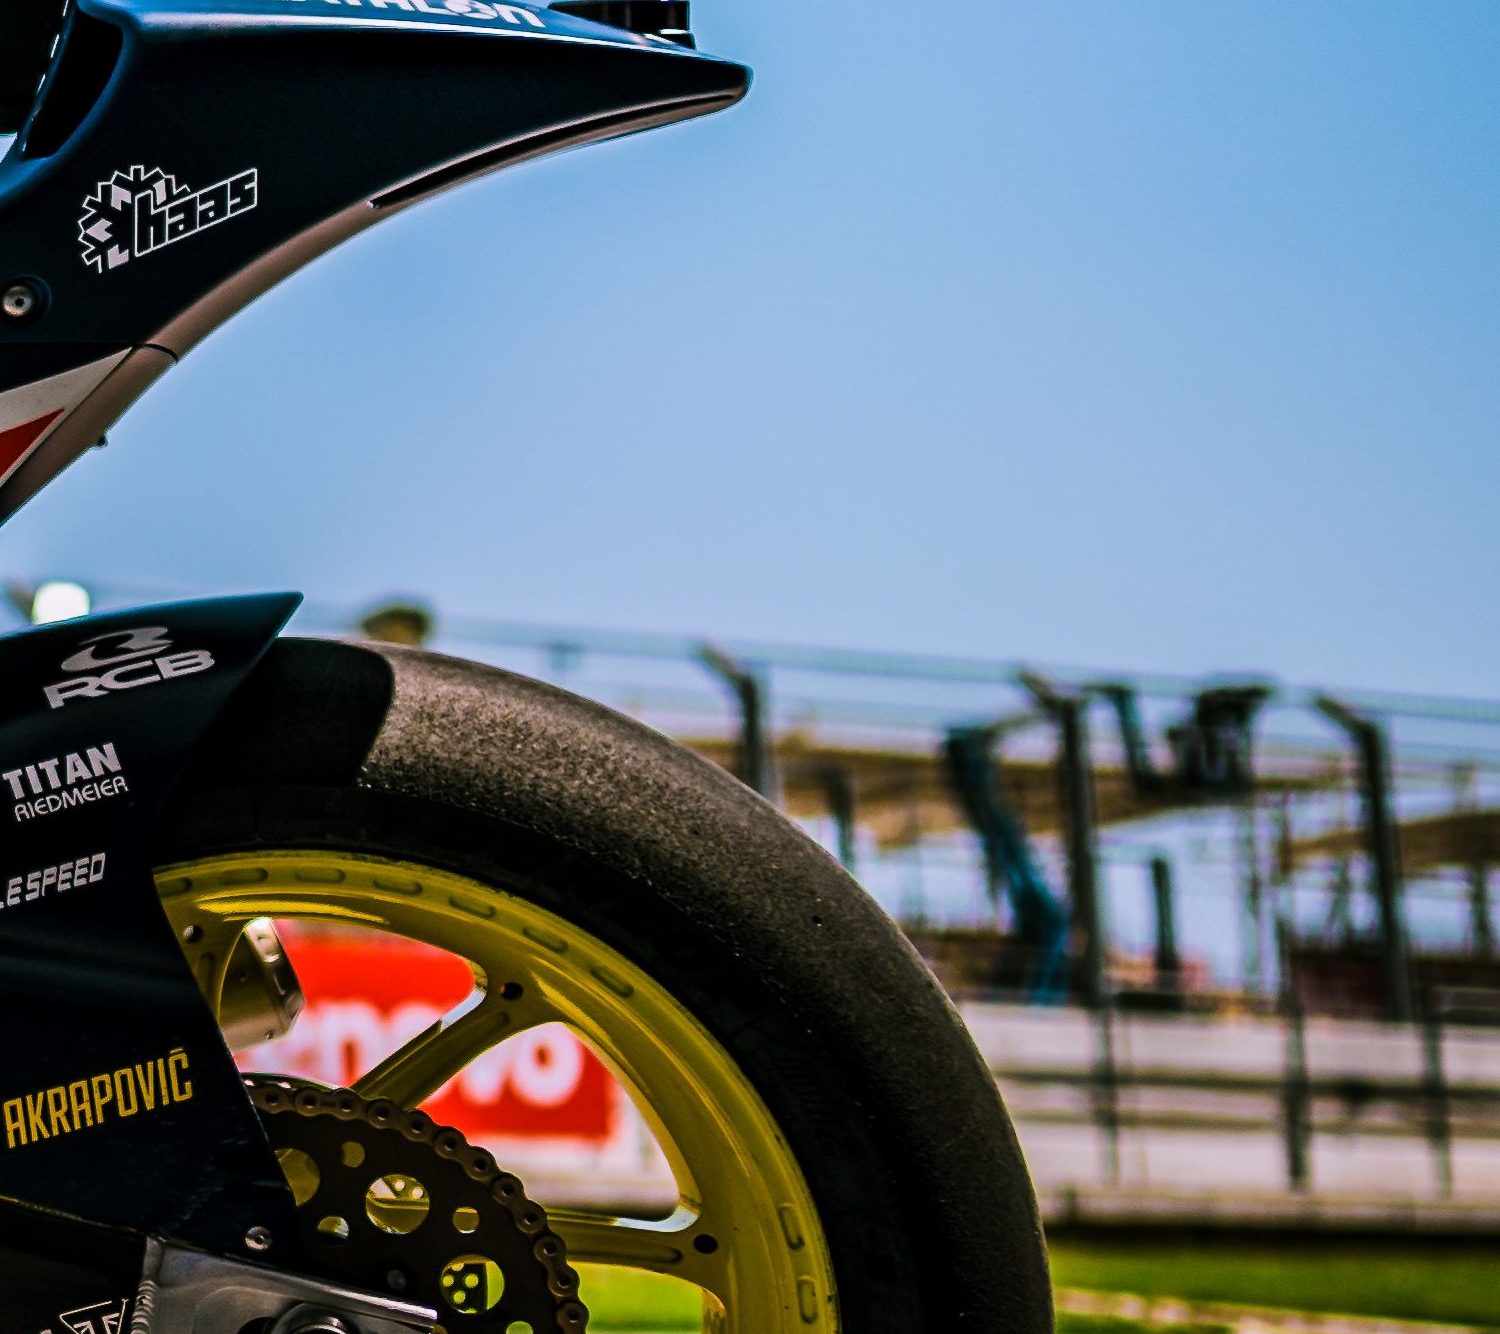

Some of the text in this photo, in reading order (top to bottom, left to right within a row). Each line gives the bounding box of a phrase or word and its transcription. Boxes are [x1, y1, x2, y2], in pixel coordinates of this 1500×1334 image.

[134, 168, 257, 257] haas
[43, 649, 216, 709] RCB
[2, 742, 122, 799] TITAN
[13, 775, 129, 822] RIEDMEIER
